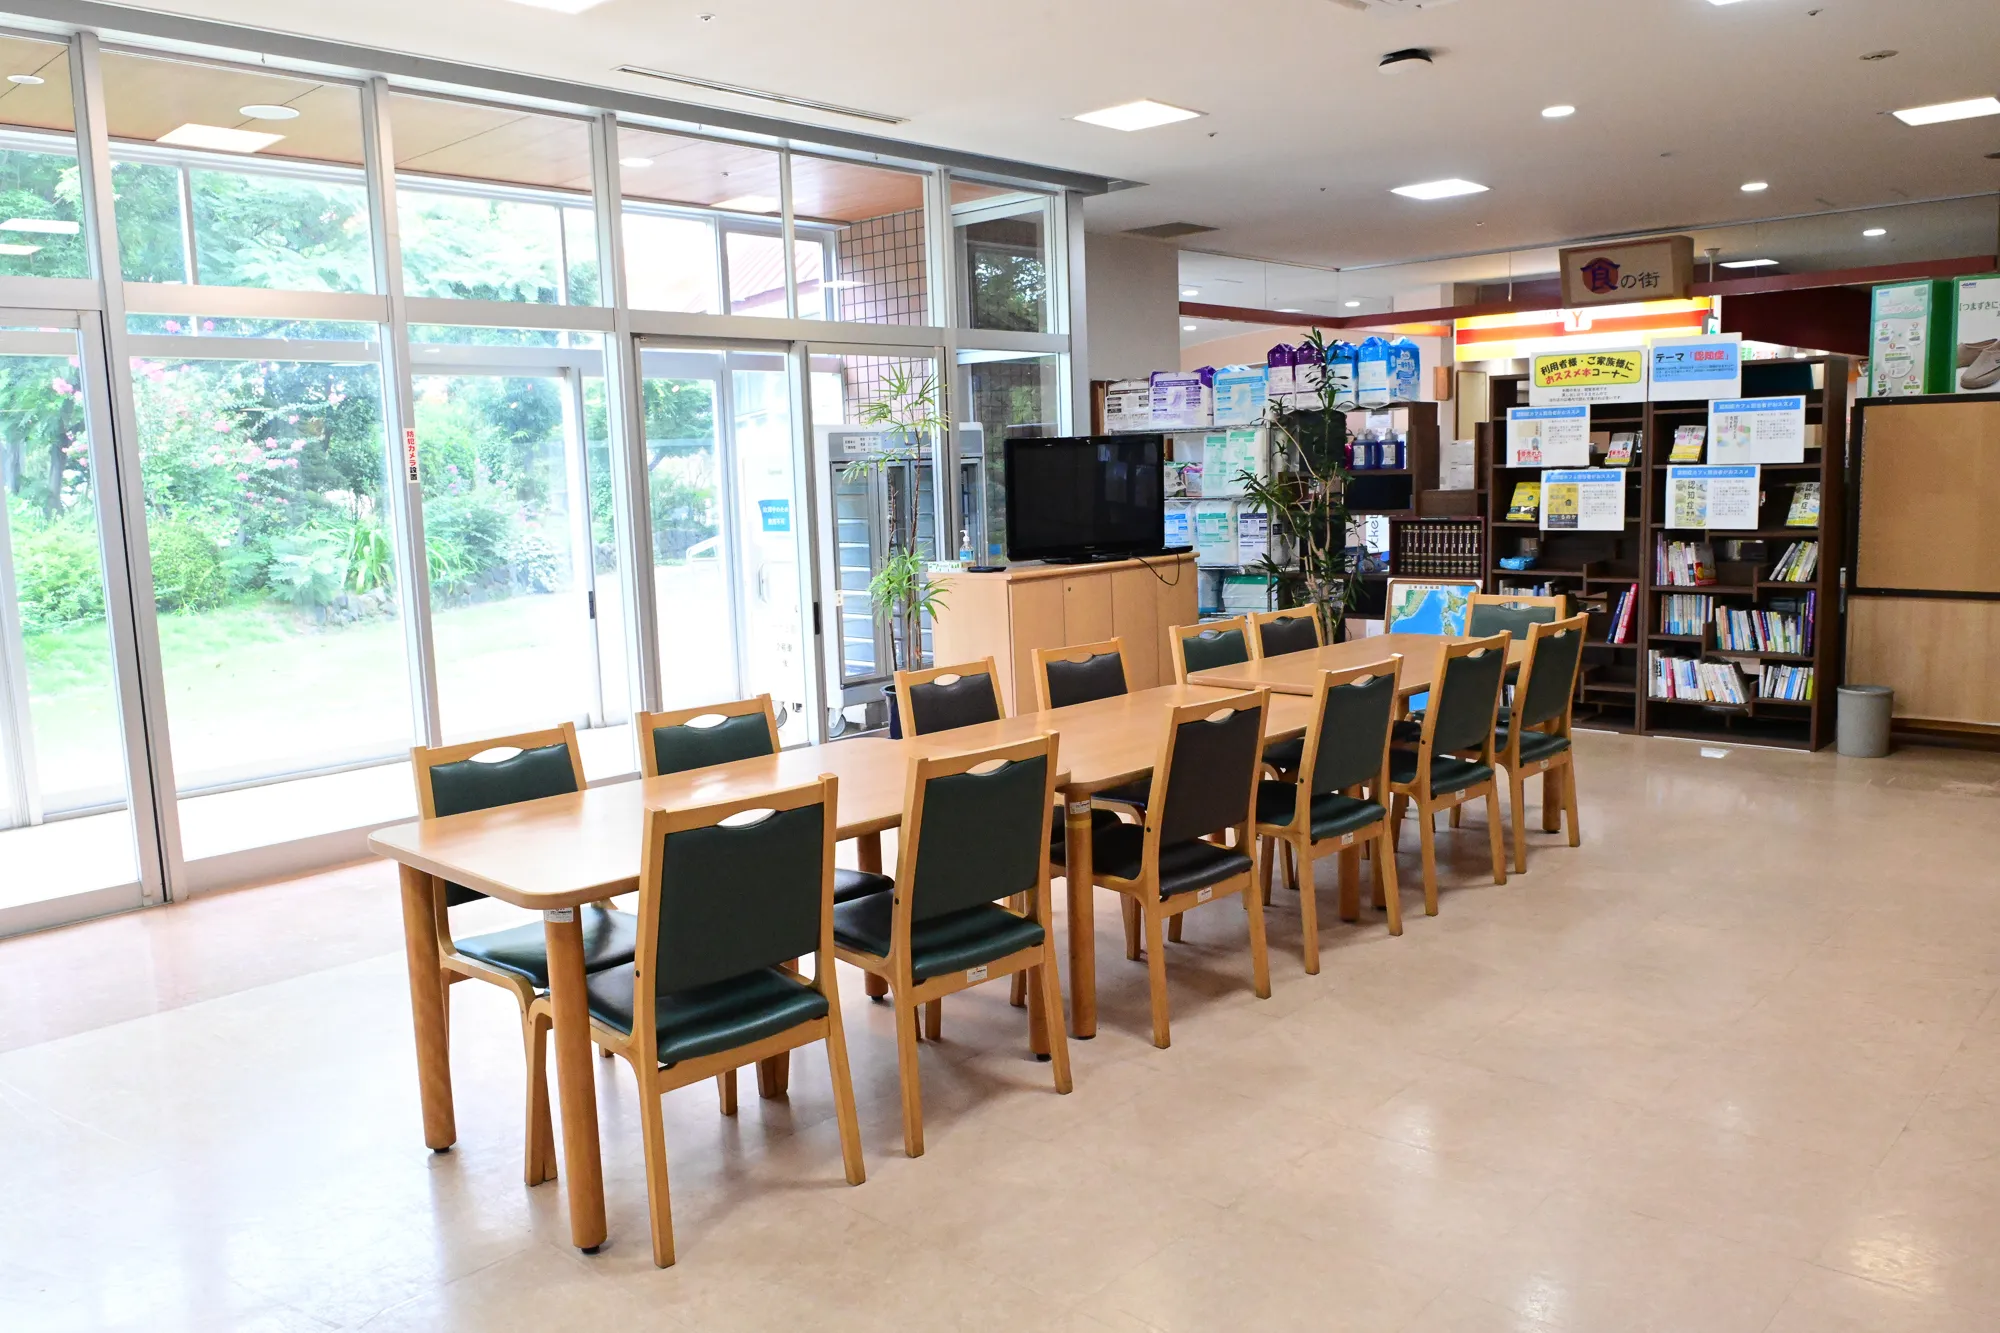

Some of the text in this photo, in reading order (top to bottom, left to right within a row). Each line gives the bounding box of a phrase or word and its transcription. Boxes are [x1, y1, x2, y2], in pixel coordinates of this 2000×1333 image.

[1580, 257, 1660, 290] 食の街
[1959, 301, 2000, 312] 「つまずきに
[1541, 356, 1635, 376] 利用者様・ご家族様に
[1545, 368, 1629, 385] おススメ本コーナー
[406, 431, 418, 481] 防犯カメラ設置
[1367, 514, 1380, 553] icket
